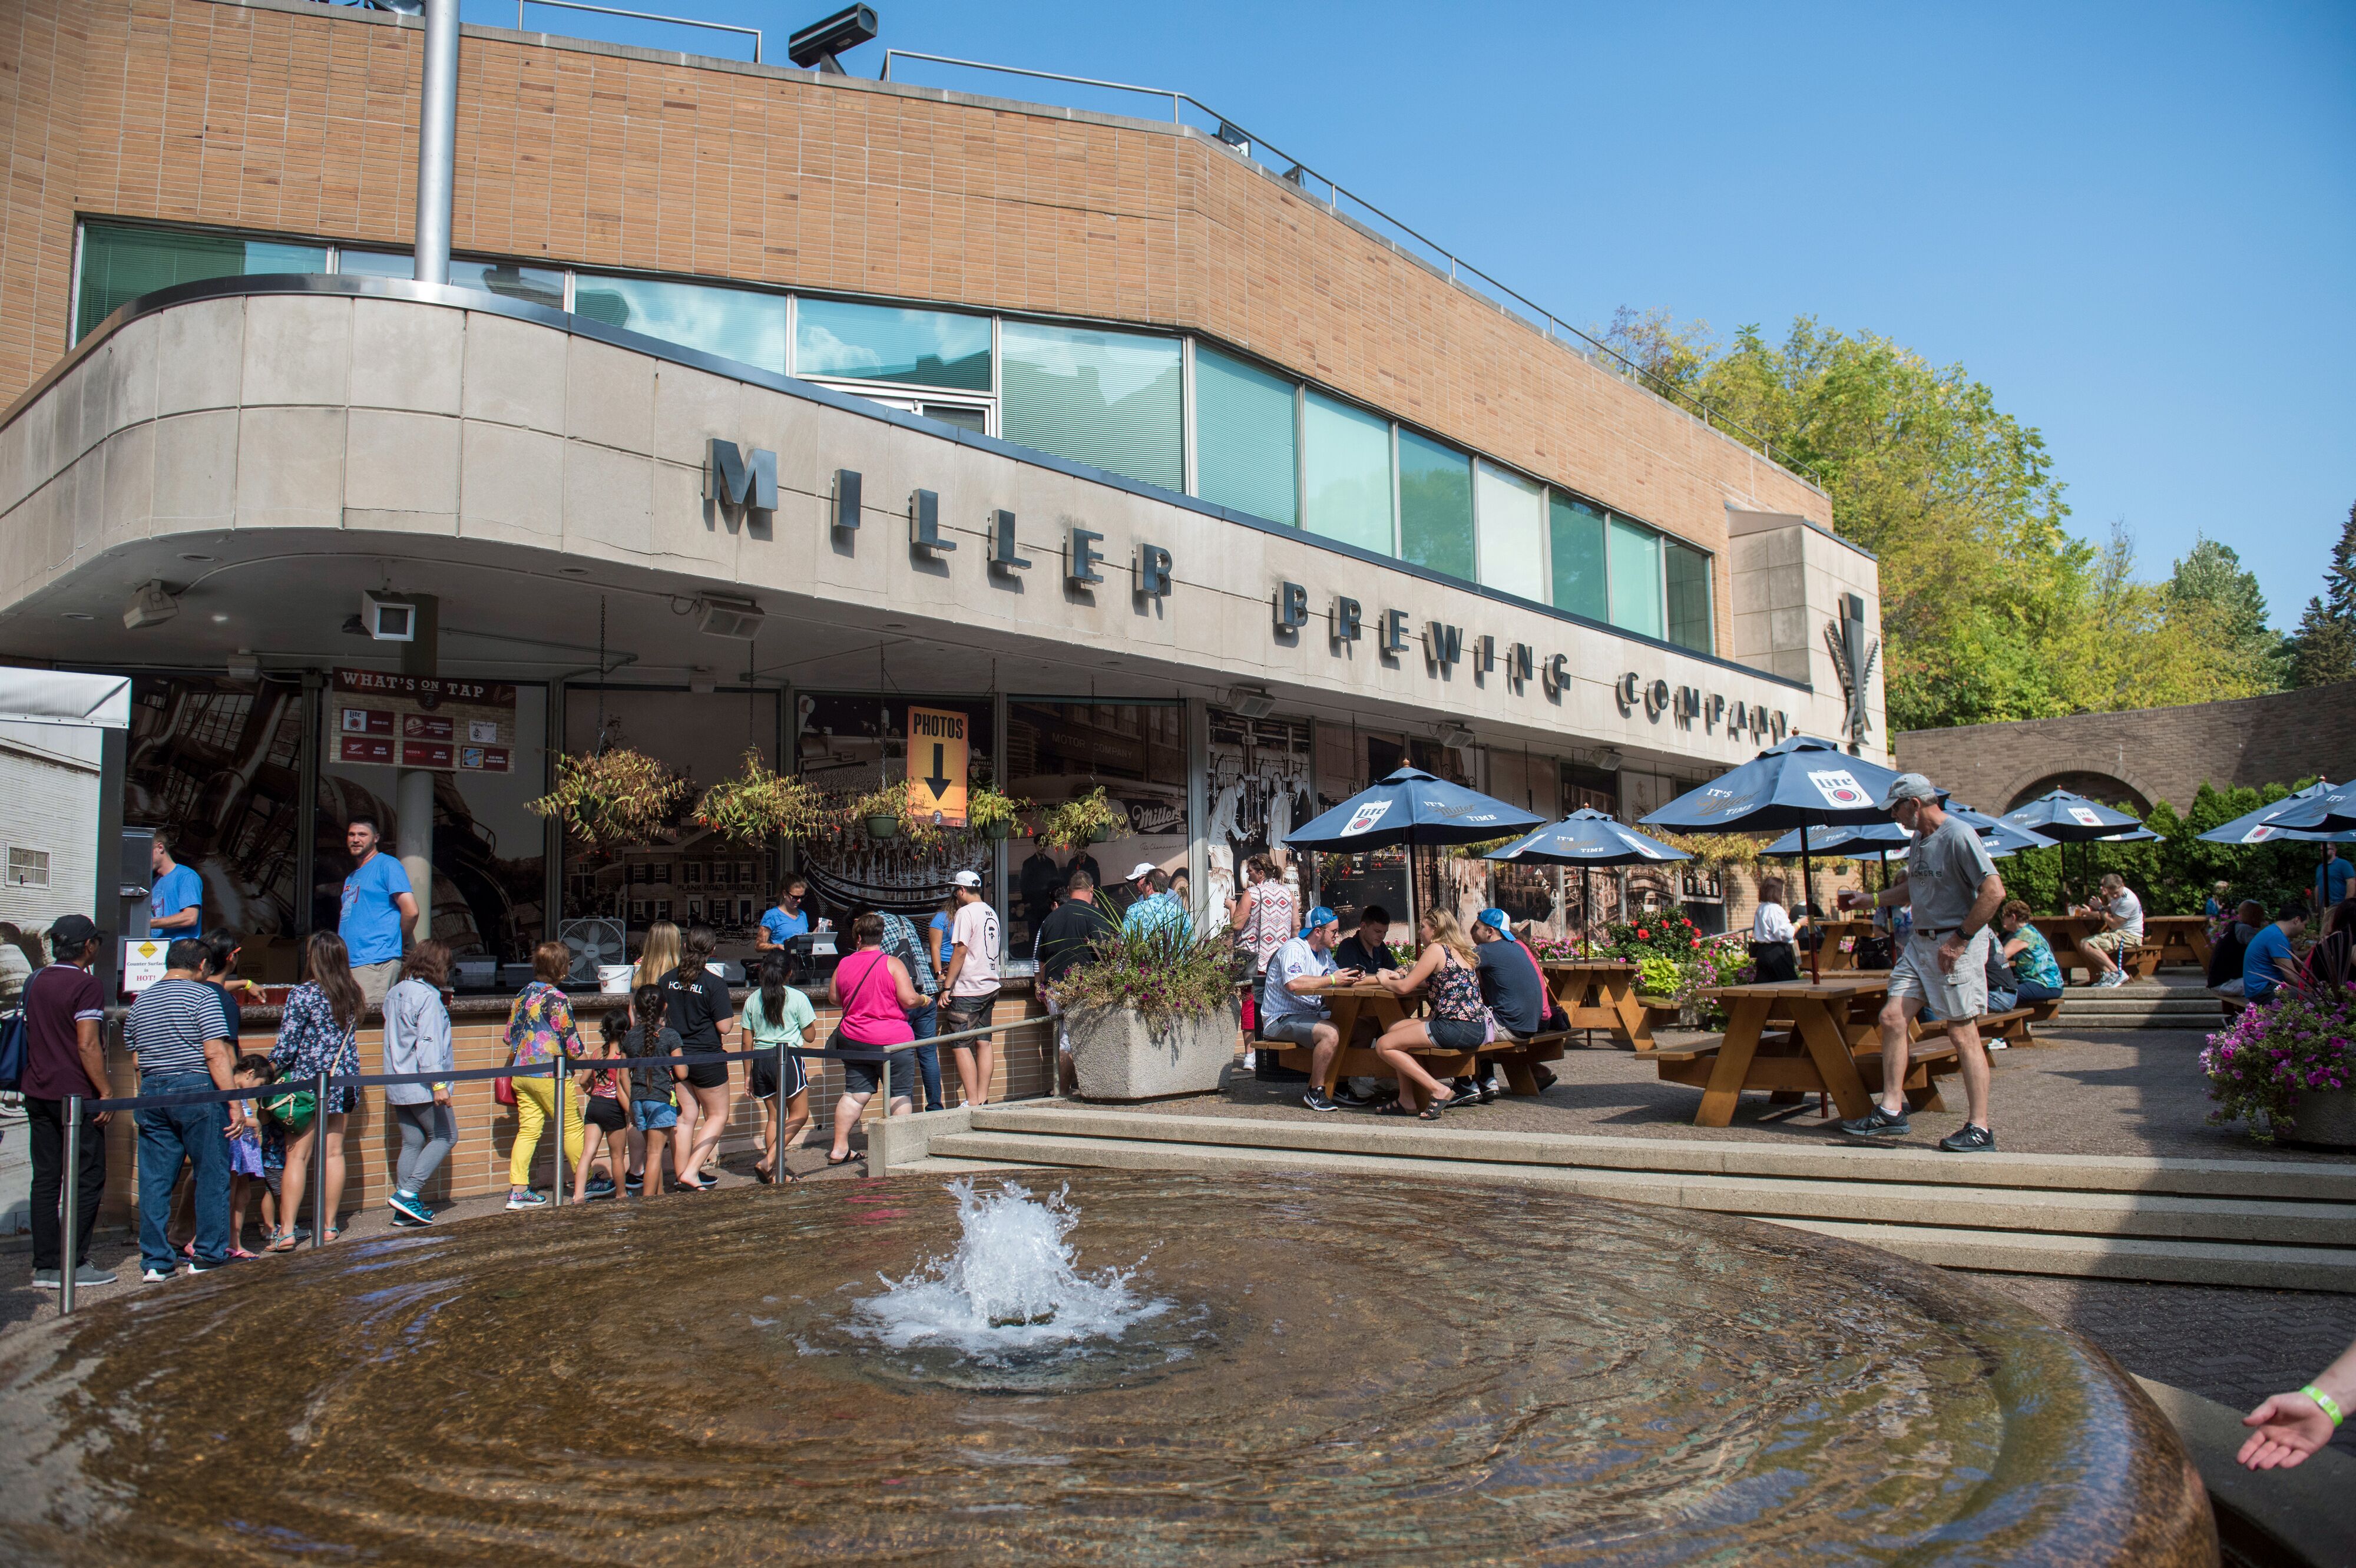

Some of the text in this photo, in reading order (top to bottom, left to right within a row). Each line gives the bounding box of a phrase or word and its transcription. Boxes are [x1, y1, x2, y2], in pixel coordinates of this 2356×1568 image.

[706, 438, 1789, 737] MILLER BREWING COMPANY
[342, 671, 484, 698] WHAT'S ON TAP
[914, 713, 963, 740] PHOTOS
[1052, 732, 1086, 749] MOTOR
[1093, 742, 1133, 759] COMPANY
[1816, 777, 1852, 789] Lite
[1706, 788, 1733, 798] IT'S
[1132, 805, 1180, 829] Miller
[1355, 806, 1387, 818] Lite
[1427, 803, 1476, 818] Miller
[1725, 803, 1754, 816] TIME
[1825, 832, 1848, 842] TIME
[1687, 878, 1719, 896] BEER
[669, 981, 703, 994] HOALL
